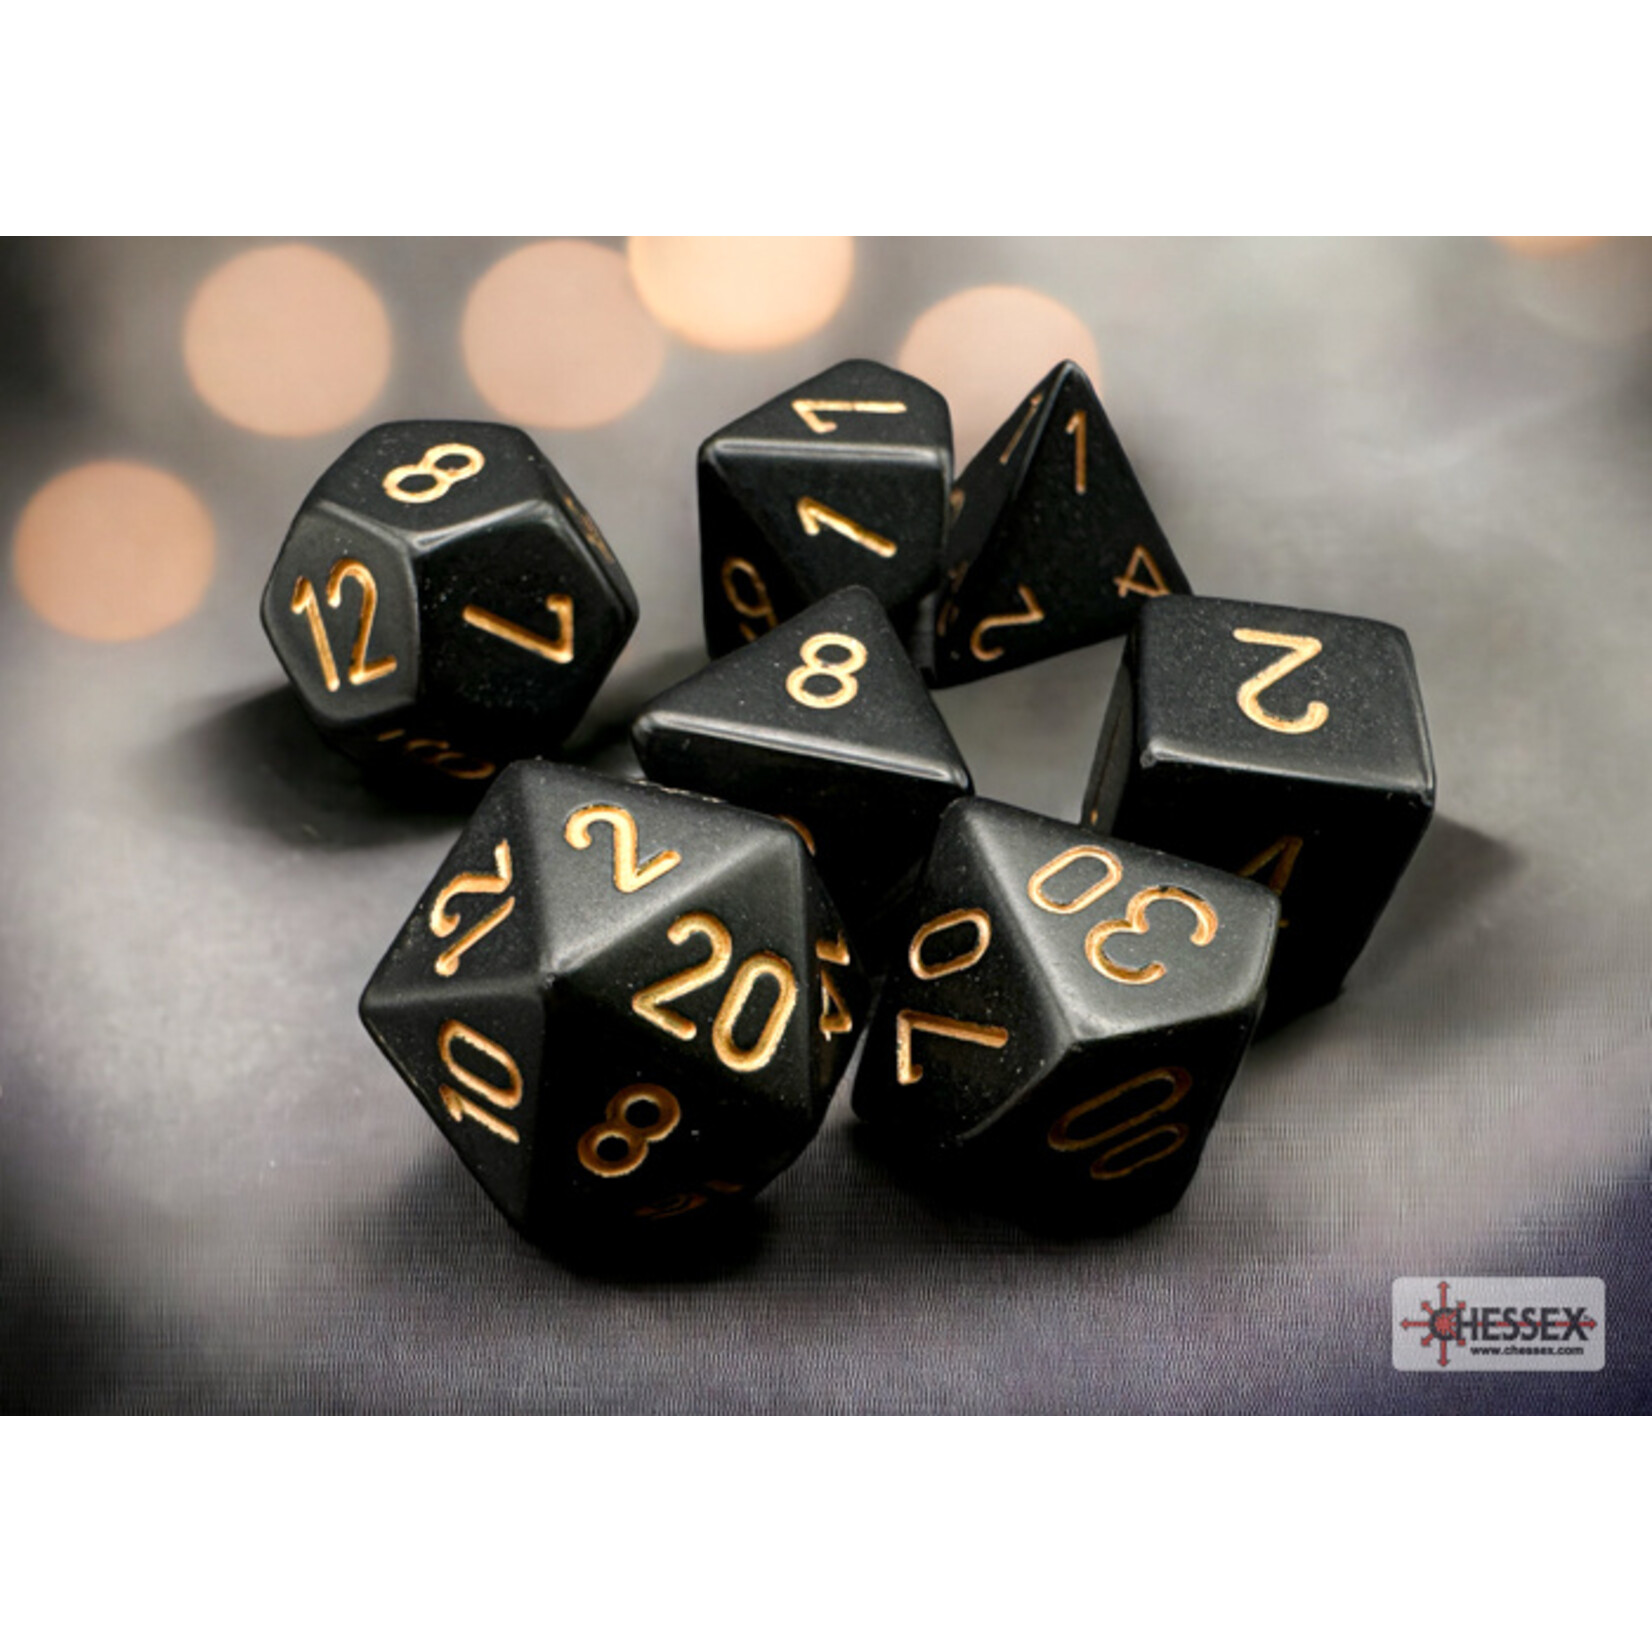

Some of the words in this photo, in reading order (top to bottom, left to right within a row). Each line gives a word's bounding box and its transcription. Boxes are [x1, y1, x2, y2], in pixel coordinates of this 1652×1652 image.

[789, 396, 908, 434] 1
[1065, 410, 1087, 494] 1
[380, 440, 486, 504] 8
[795, 495, 898, 558] 1
[288, 557, 398, 693] 12
[461, 594, 575, 665] 7
[970, 586, 1045, 661] 2
[784, 629, 869, 710] 8
[1232, 626, 1330, 735] 2
[562, 803, 683, 895] 2
[427, 839, 516, 977] 12
[1026, 844, 1220, 986] 30
[630, 911, 799, 1073] 20
[895, 907, 1010, 1086] 70
[437, 1019, 524, 1144] 10
[577, 1087, 681, 1178] 8
